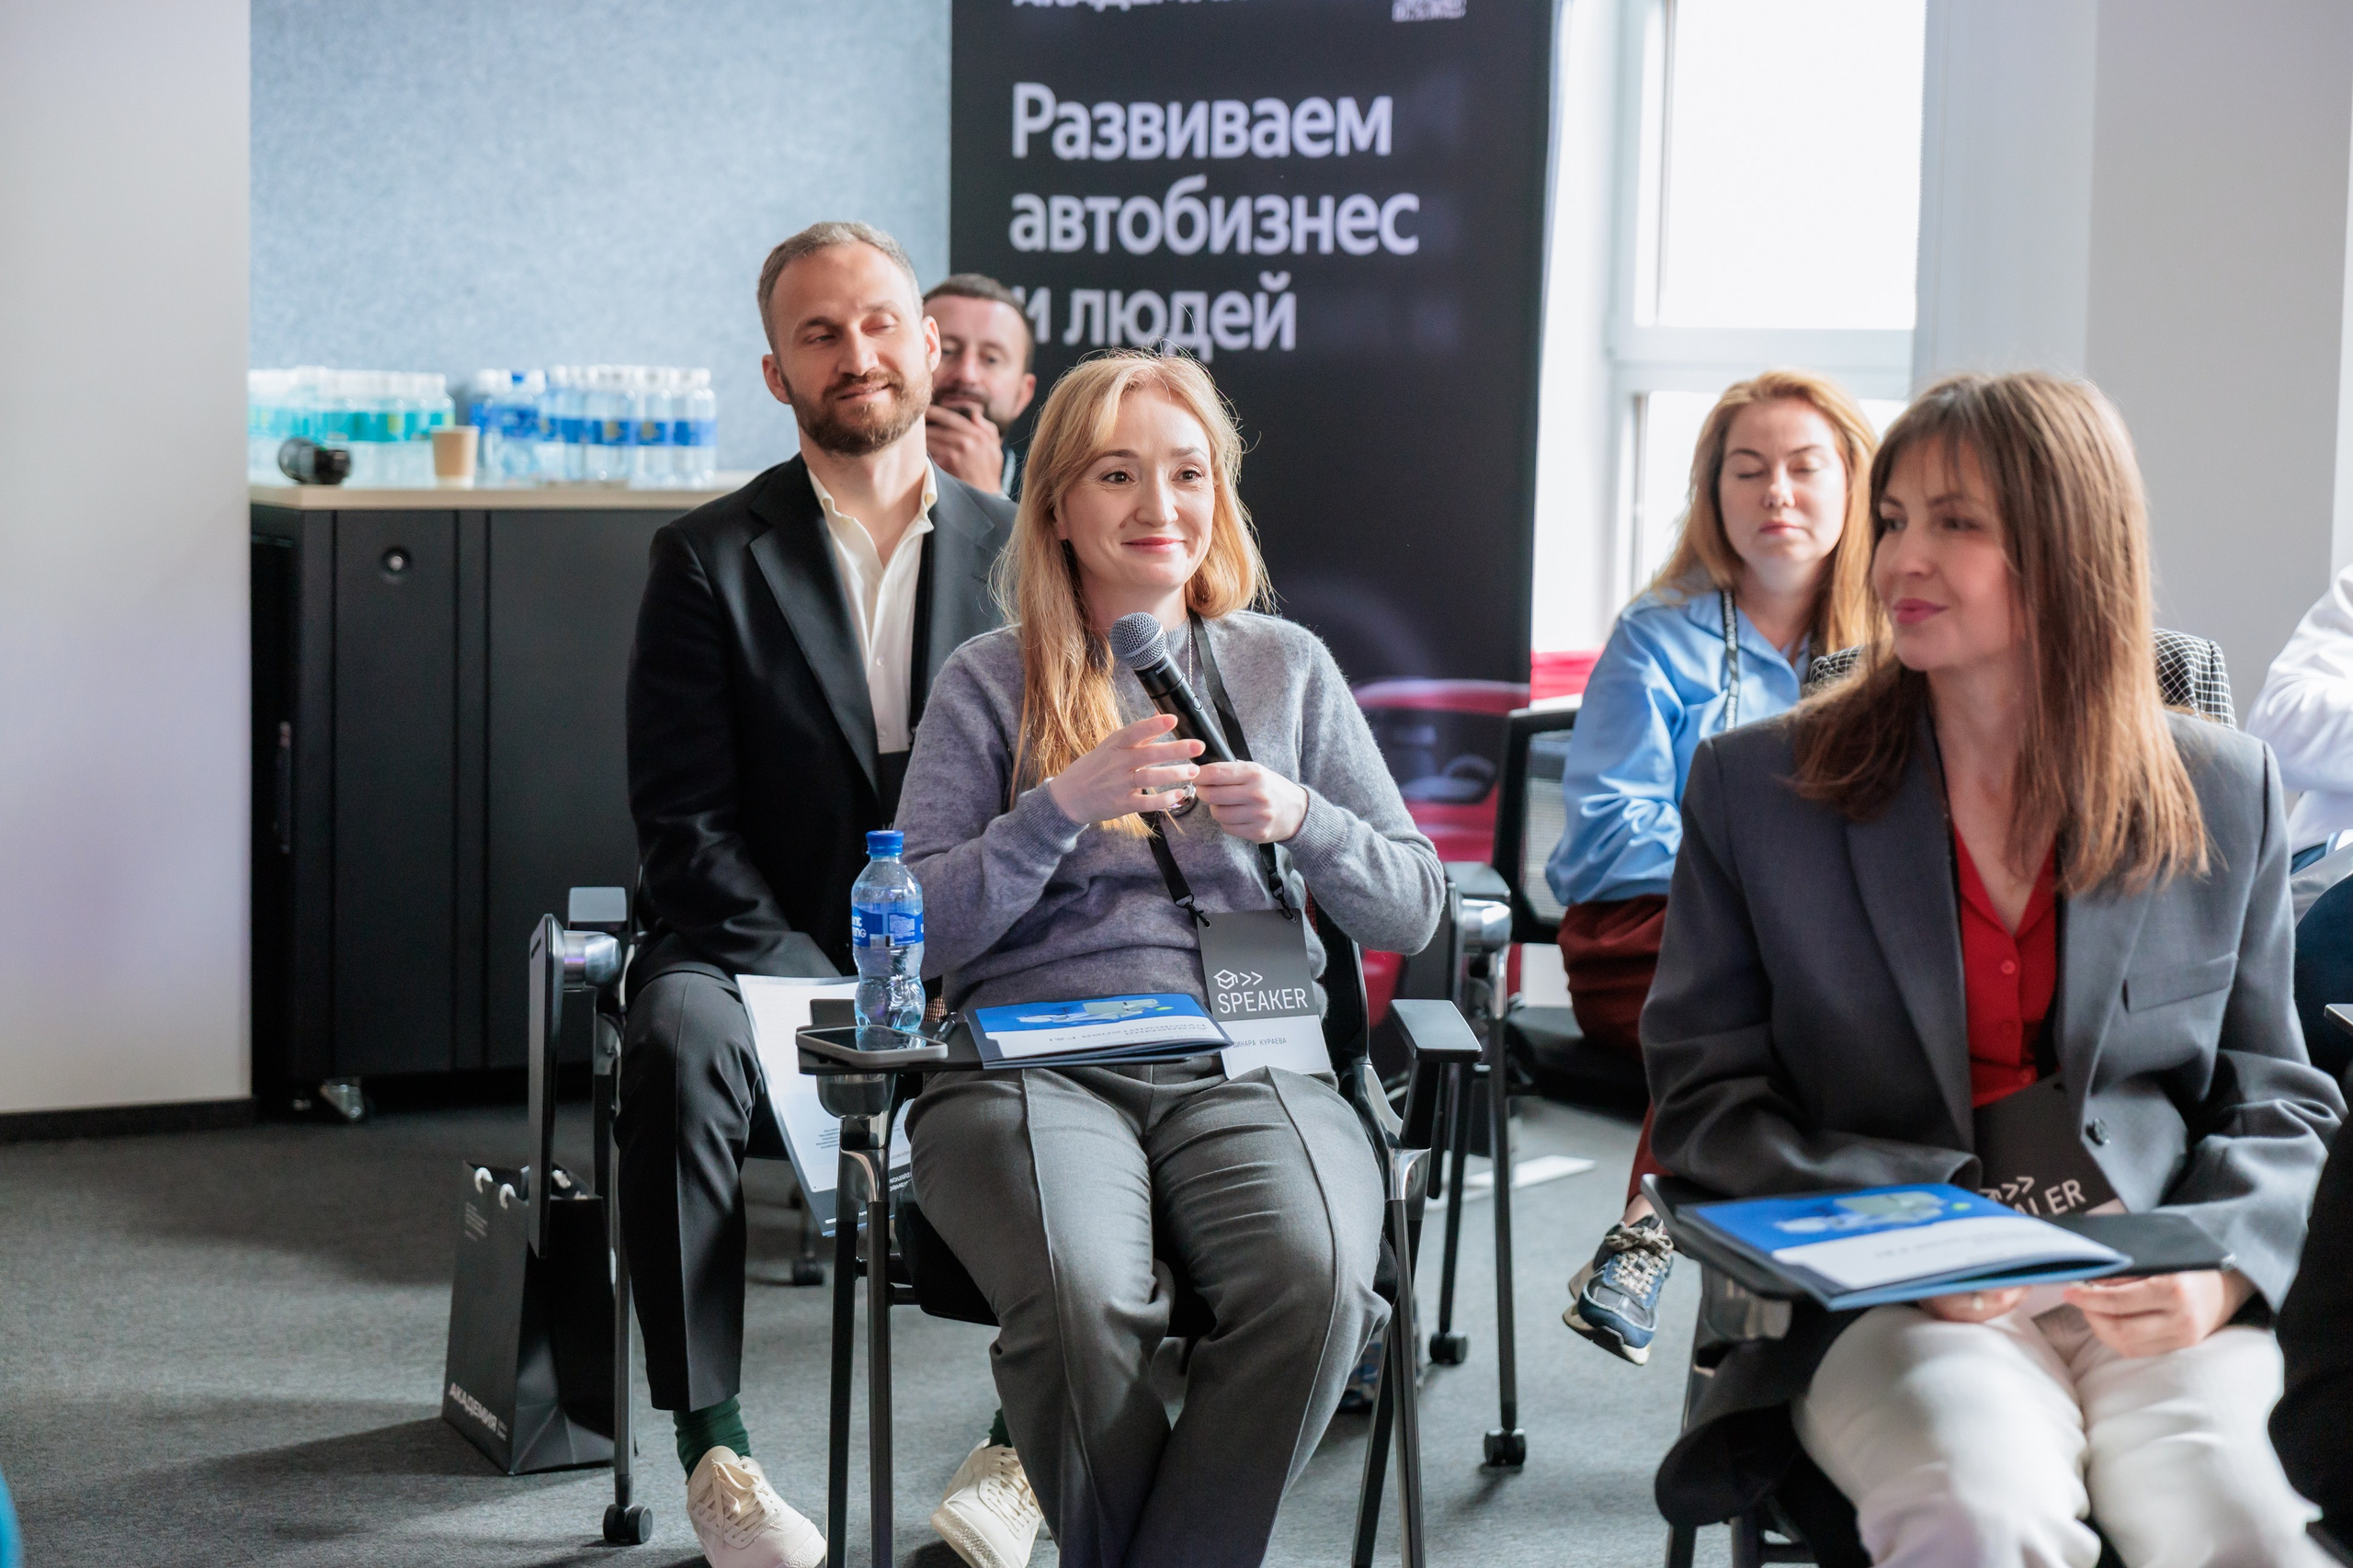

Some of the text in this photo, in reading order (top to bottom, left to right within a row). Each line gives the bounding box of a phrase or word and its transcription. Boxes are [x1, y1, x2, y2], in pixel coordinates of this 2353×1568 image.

[1012, 82, 1392, 160] Развиваем
[1009, 175, 1419, 256] автобизнес
[1063, 272, 1297, 364] людей
[1218, 987, 1309, 1014] SPEAKER
[1233, 1038, 1287, 1049] ДИНАРА КУРАЕВА
